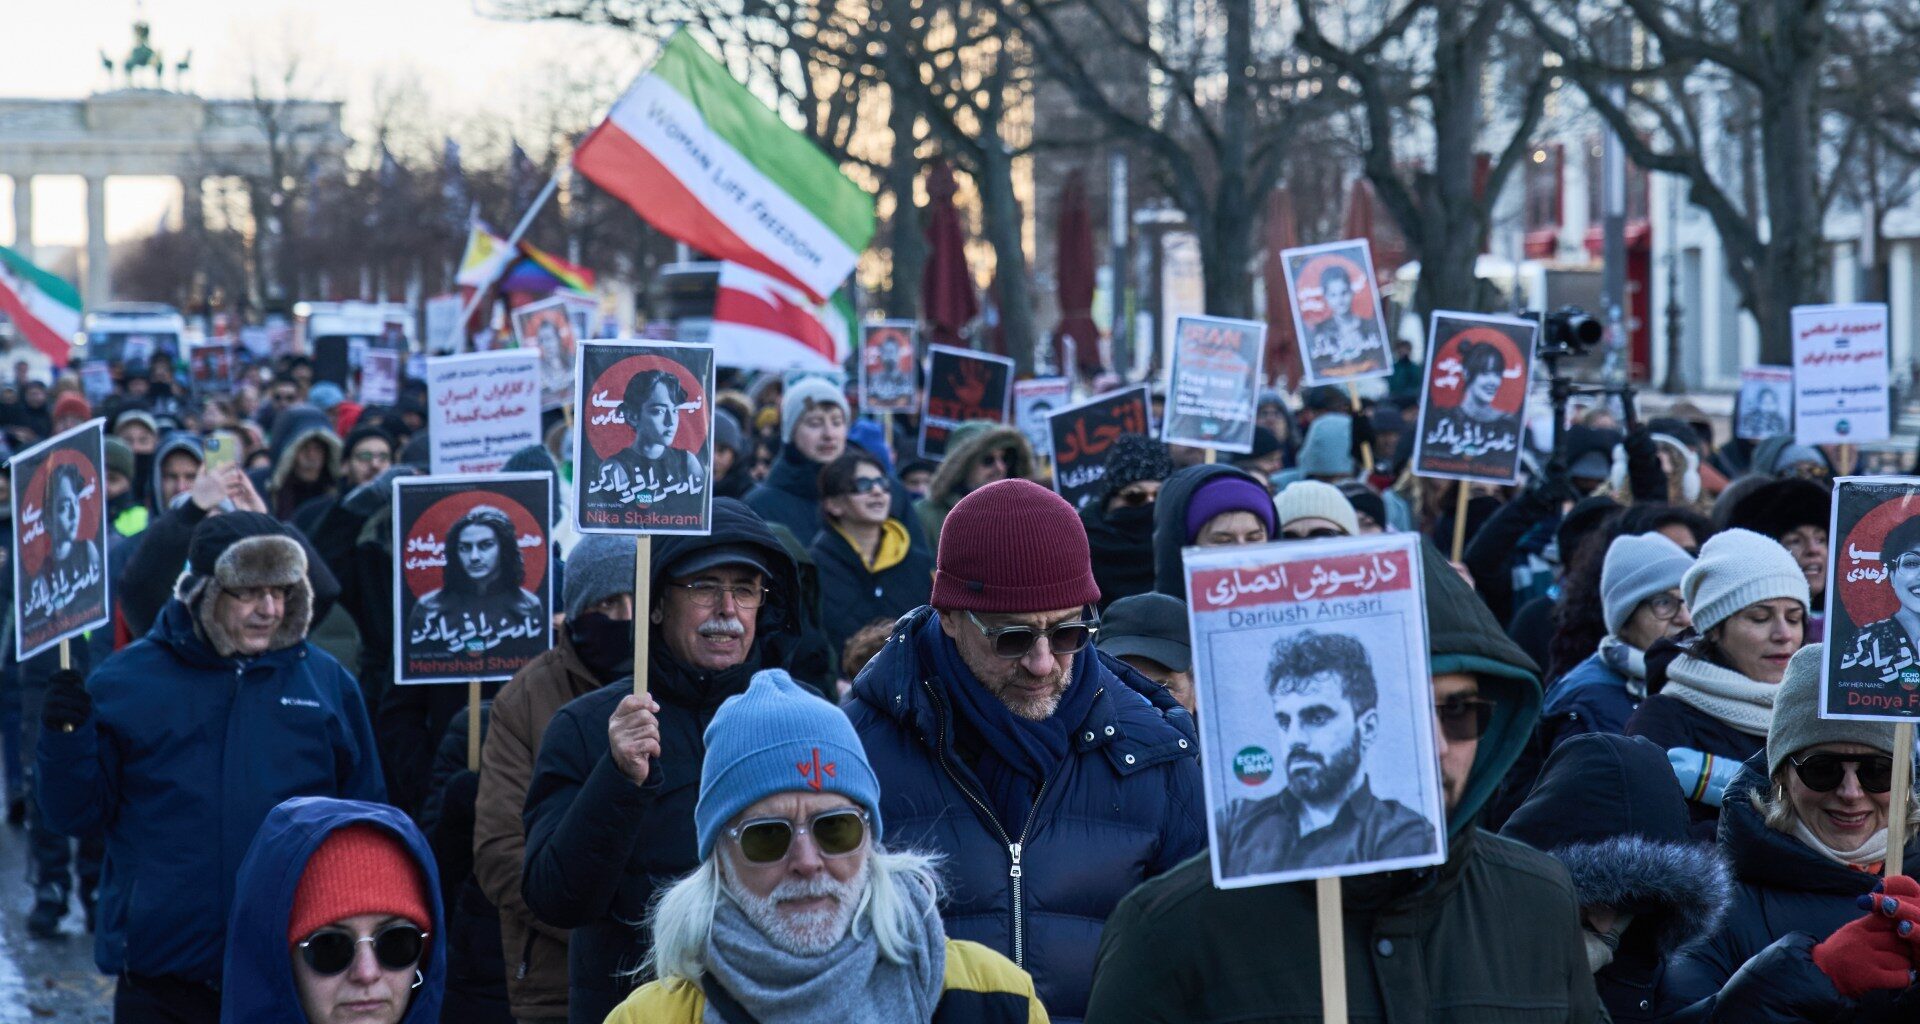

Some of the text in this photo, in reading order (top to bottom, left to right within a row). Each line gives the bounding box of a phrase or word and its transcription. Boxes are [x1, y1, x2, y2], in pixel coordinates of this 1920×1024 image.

[1843, 485, 1872, 493] WOMAN
[586, 510, 703, 526] Nika Shakarami
[1206, 554, 1399, 607] داریوش انصاری
[1847, 563, 1888, 583] فرهادی
[1228, 597, 1383, 629] Dariush Ansari
[409, 656, 529, 674] Mehrshad Shahi
[1848, 691, 1903, 709] Donya
[1235, 753, 1270, 767] ECHO
[1242, 762, 1273, 775] IRAN
